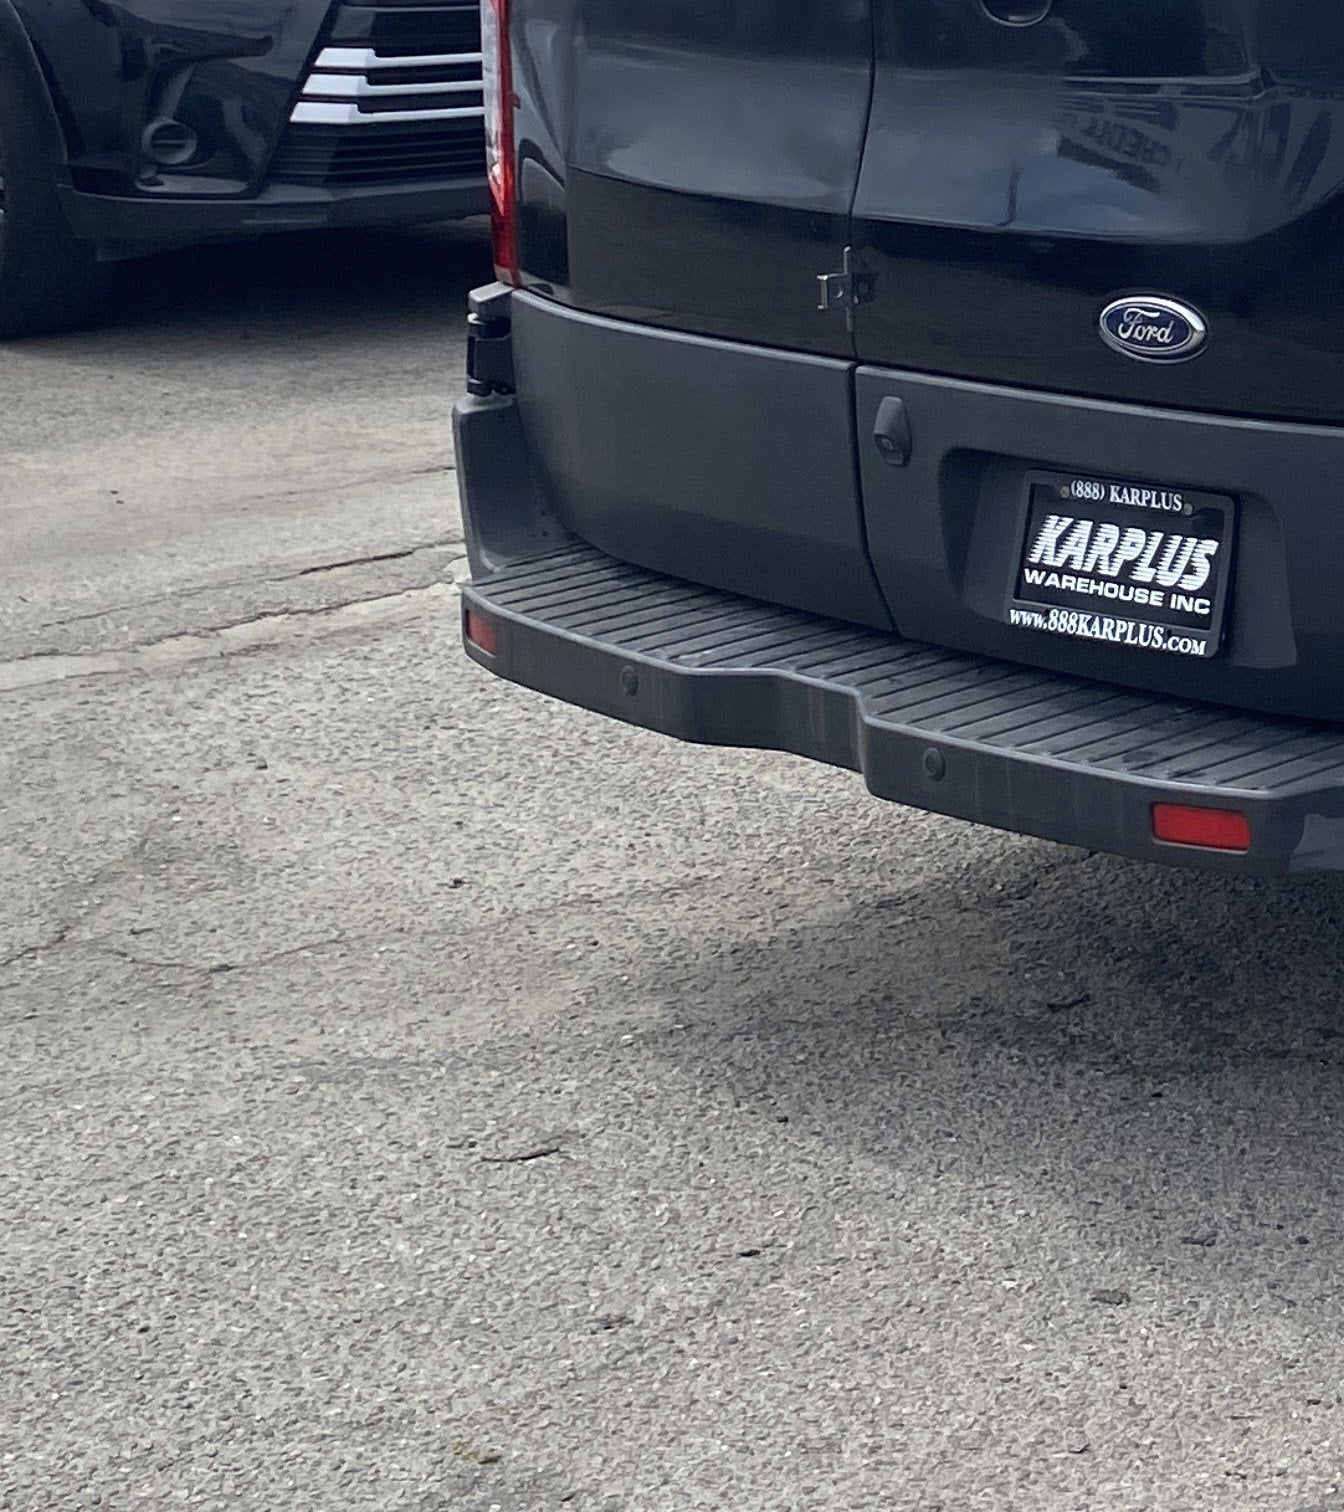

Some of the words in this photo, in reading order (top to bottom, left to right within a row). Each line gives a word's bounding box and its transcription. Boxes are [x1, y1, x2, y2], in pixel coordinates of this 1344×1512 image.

[1118, 307, 1174, 344] Ford
[1070, 480, 1105, 501] (888)
[1109, 485, 1182, 511] KARPLUS
[1026, 514, 1219, 591] KARPLUS
[1023, 568, 1164, 607] WAREHOUSE
[1169, 593, 1211, 614] INC
